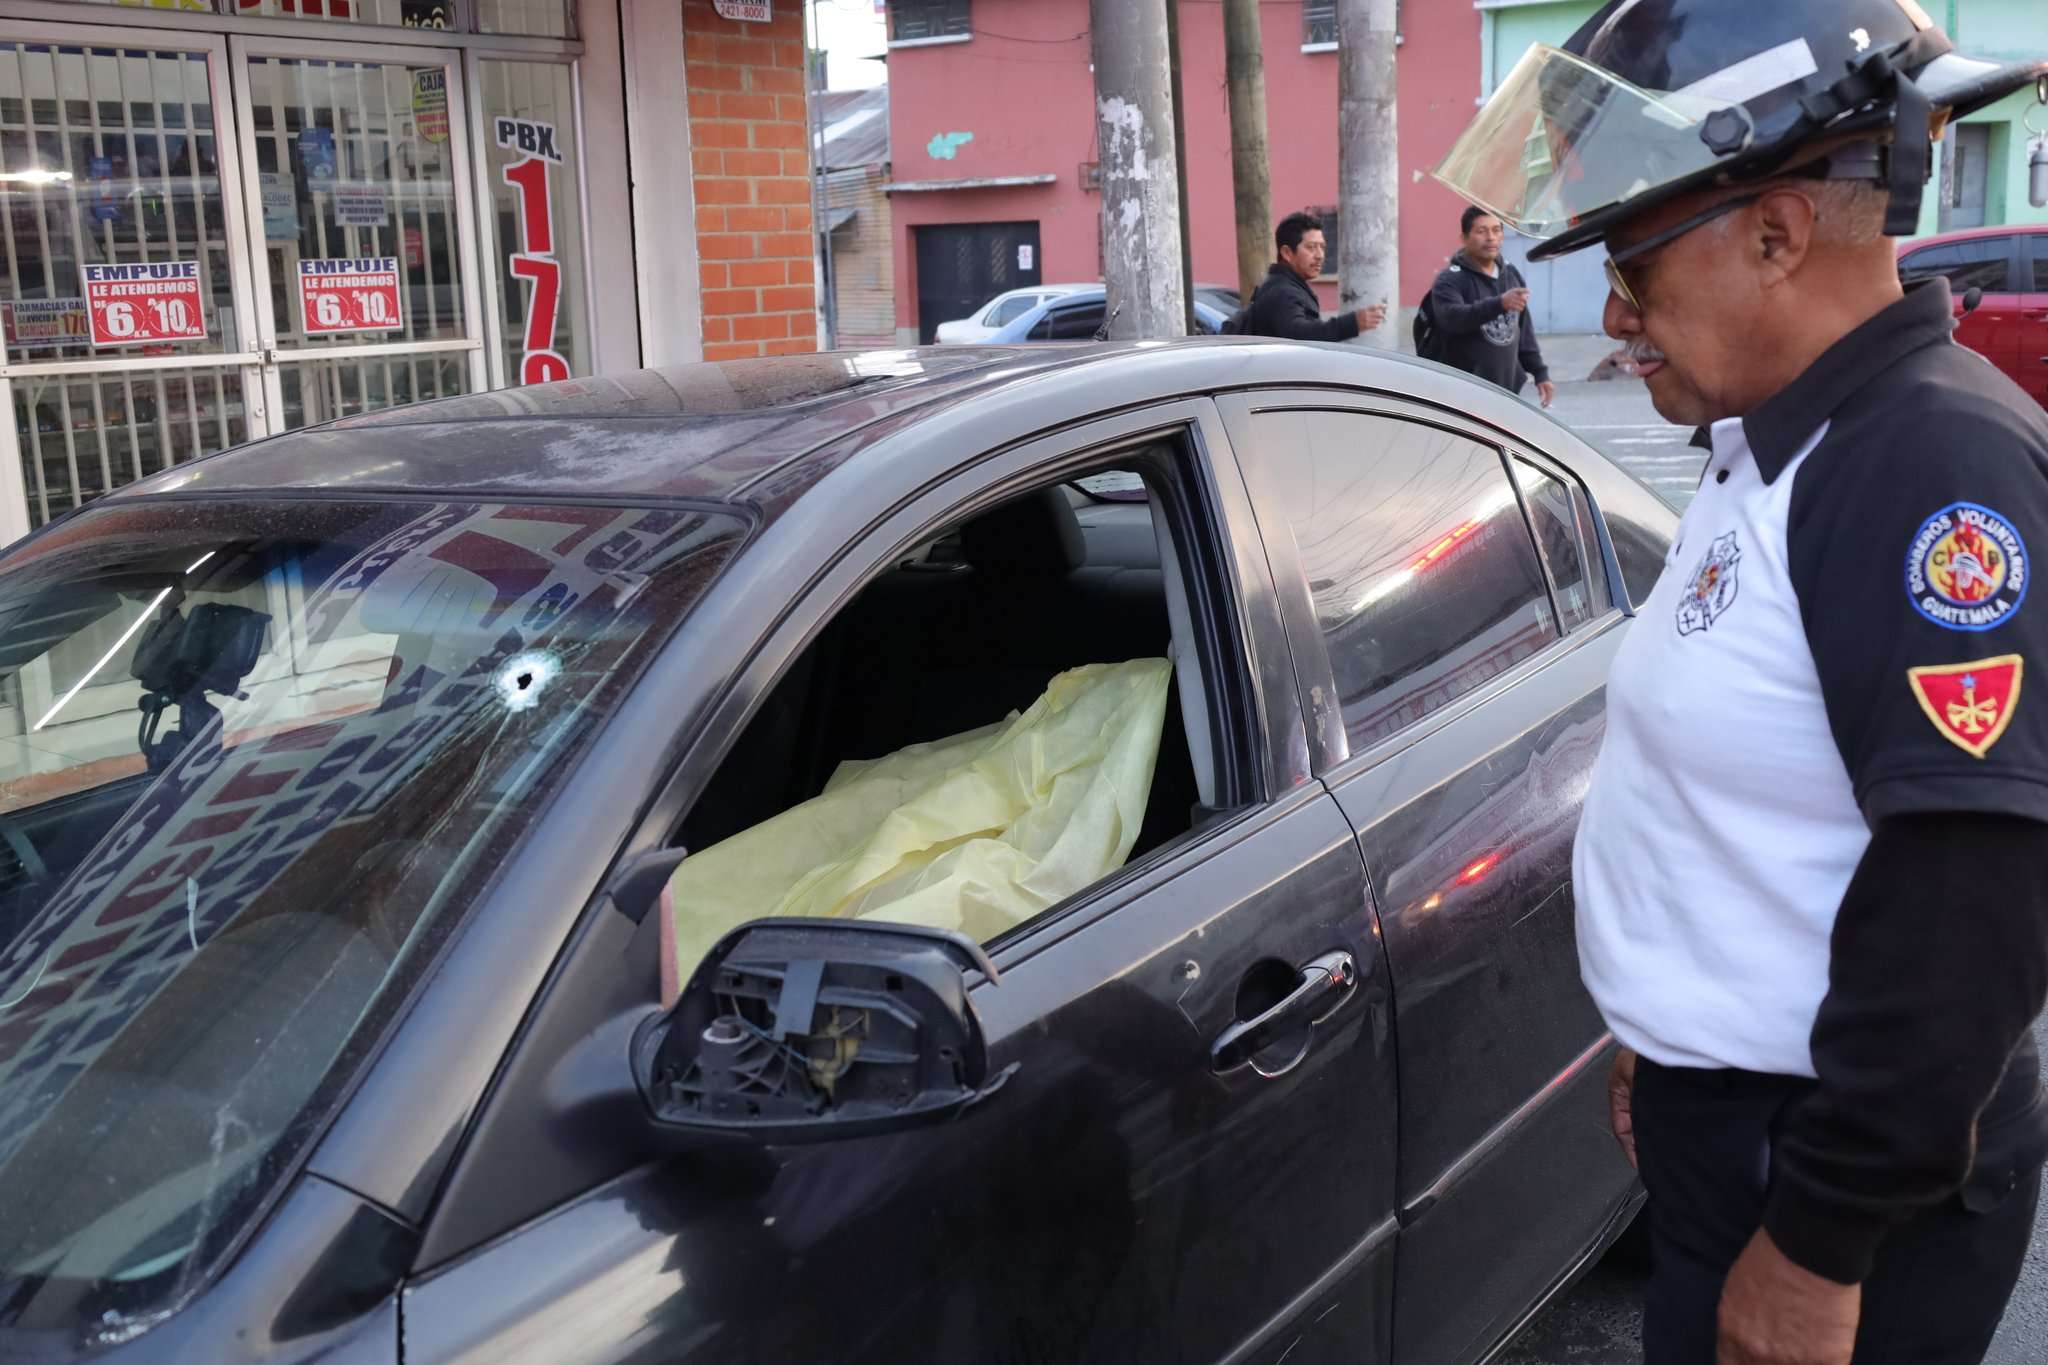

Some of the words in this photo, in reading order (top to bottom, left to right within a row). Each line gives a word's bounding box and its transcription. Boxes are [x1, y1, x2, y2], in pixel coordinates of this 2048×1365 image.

[498, 120, 562, 161] PBX.
[86, 263, 197, 280] EMPUJE
[300, 258, 395, 274] EMPUJE
[92, 285, 108, 296] LE
[111, 281, 197, 296] ATENDEMOS
[305, 278, 319, 288] LE
[321, 275, 394, 288] ATENDEMOS
[14, 302, 67, 312] FARMACIAS
[317, 293, 341, 326] 6
[359, 291, 386, 323] 10
[94, 300, 107, 309] DE
[106, 301, 135, 337] 6
[155, 300, 187, 333] 10
[1908, 514, 1953, 595] BOMBEROS
[1956, 508, 2025, 593] VOLUNTARIOS
[1921, 596, 2012, 624] GUATEMALA
